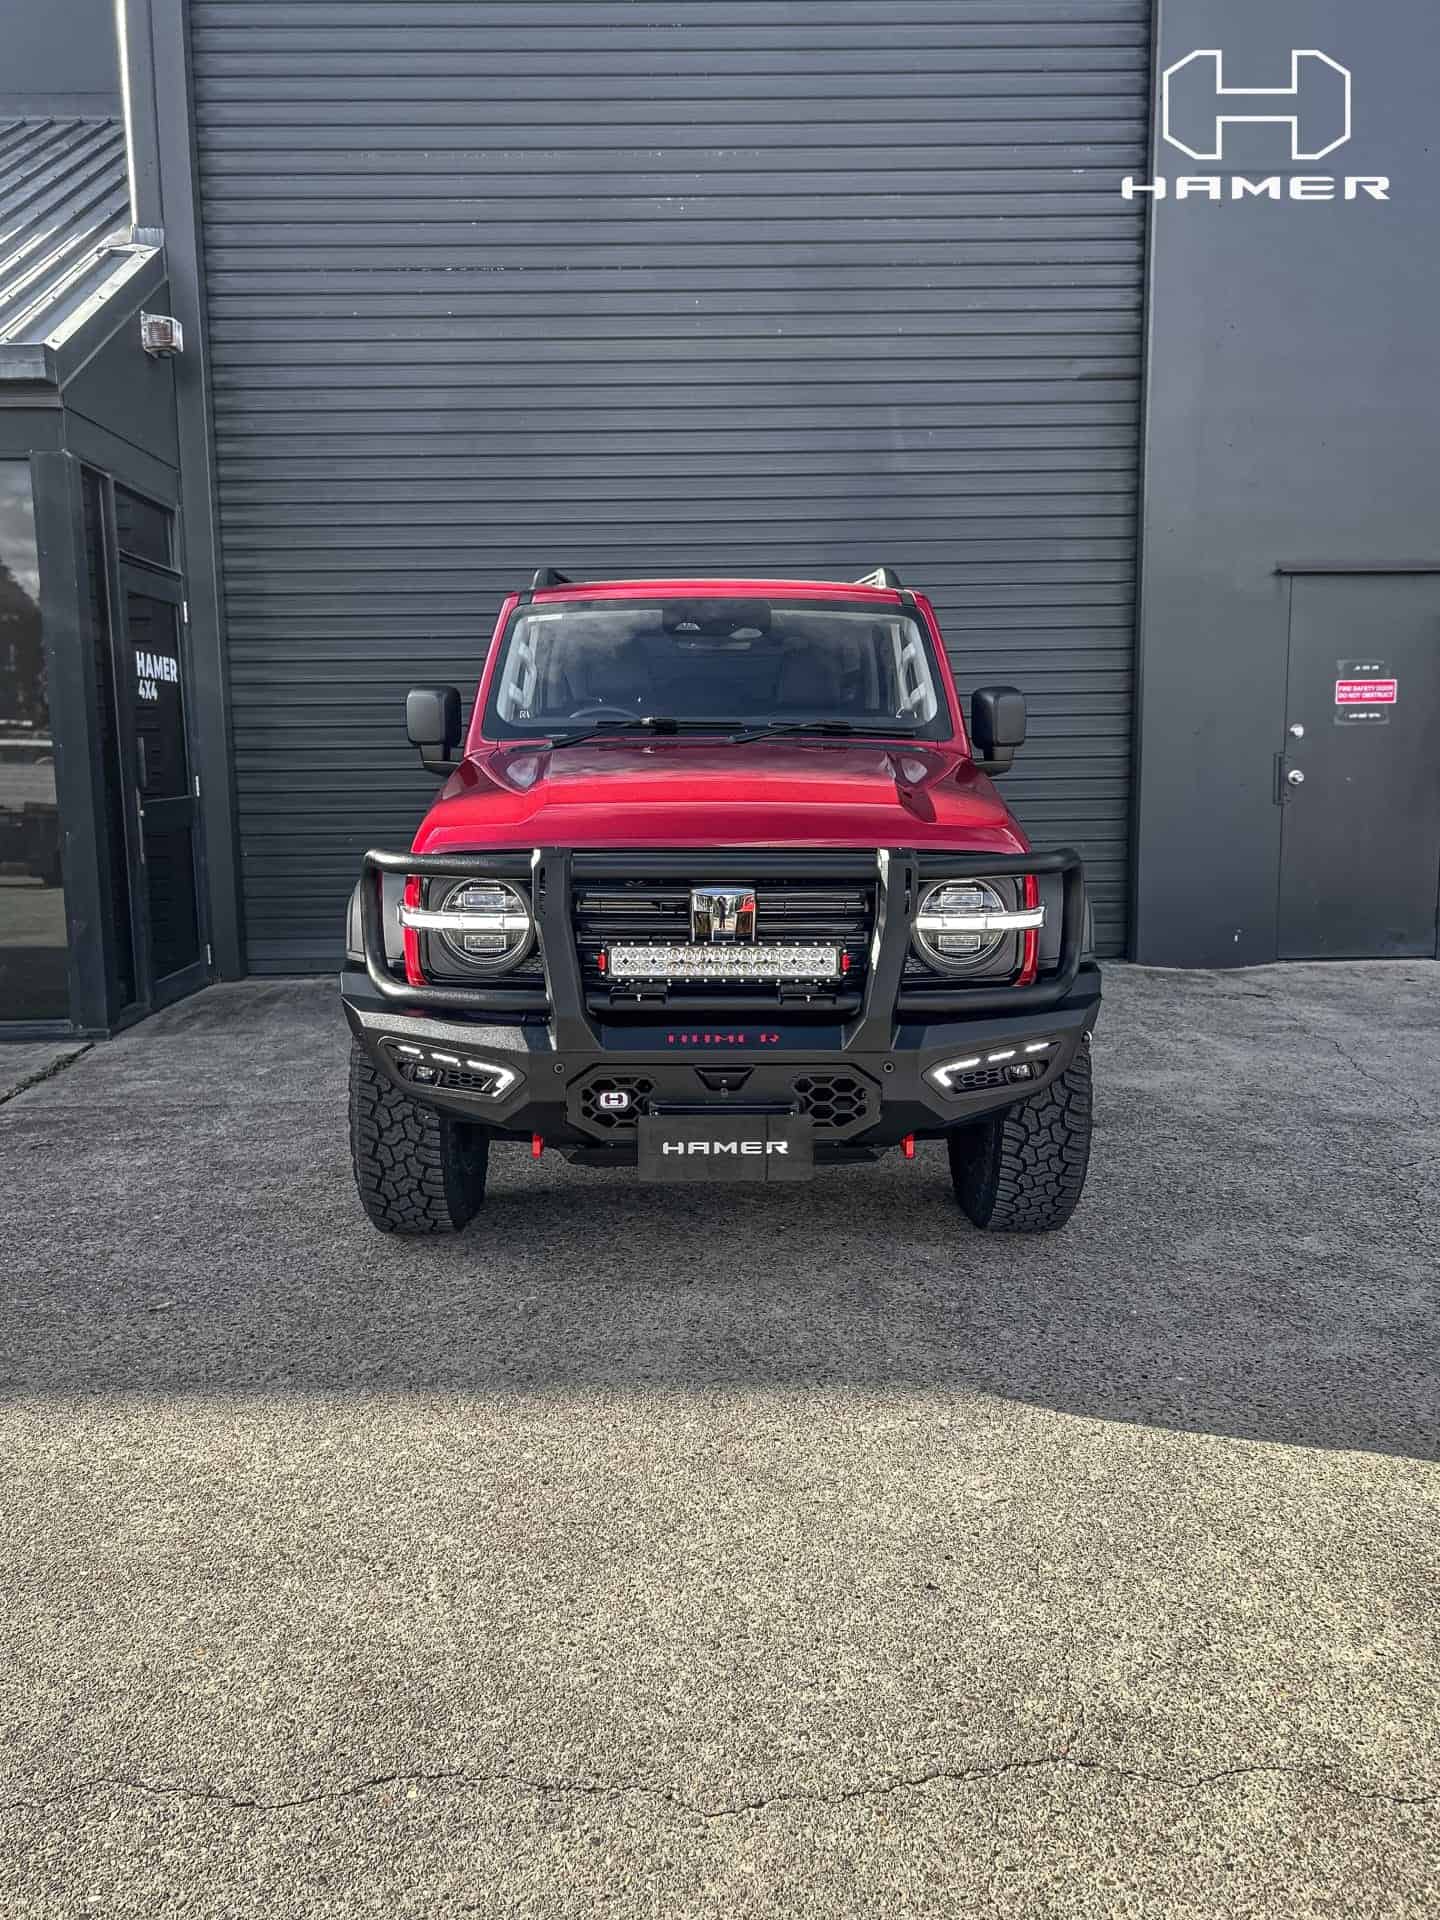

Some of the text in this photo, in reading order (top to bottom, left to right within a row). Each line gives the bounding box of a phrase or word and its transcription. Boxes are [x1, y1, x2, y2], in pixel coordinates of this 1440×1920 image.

[136, 650, 178, 683] HAMER
[138, 680, 158, 701] 4X4
[662, 1141, 789, 1155] HAMER
